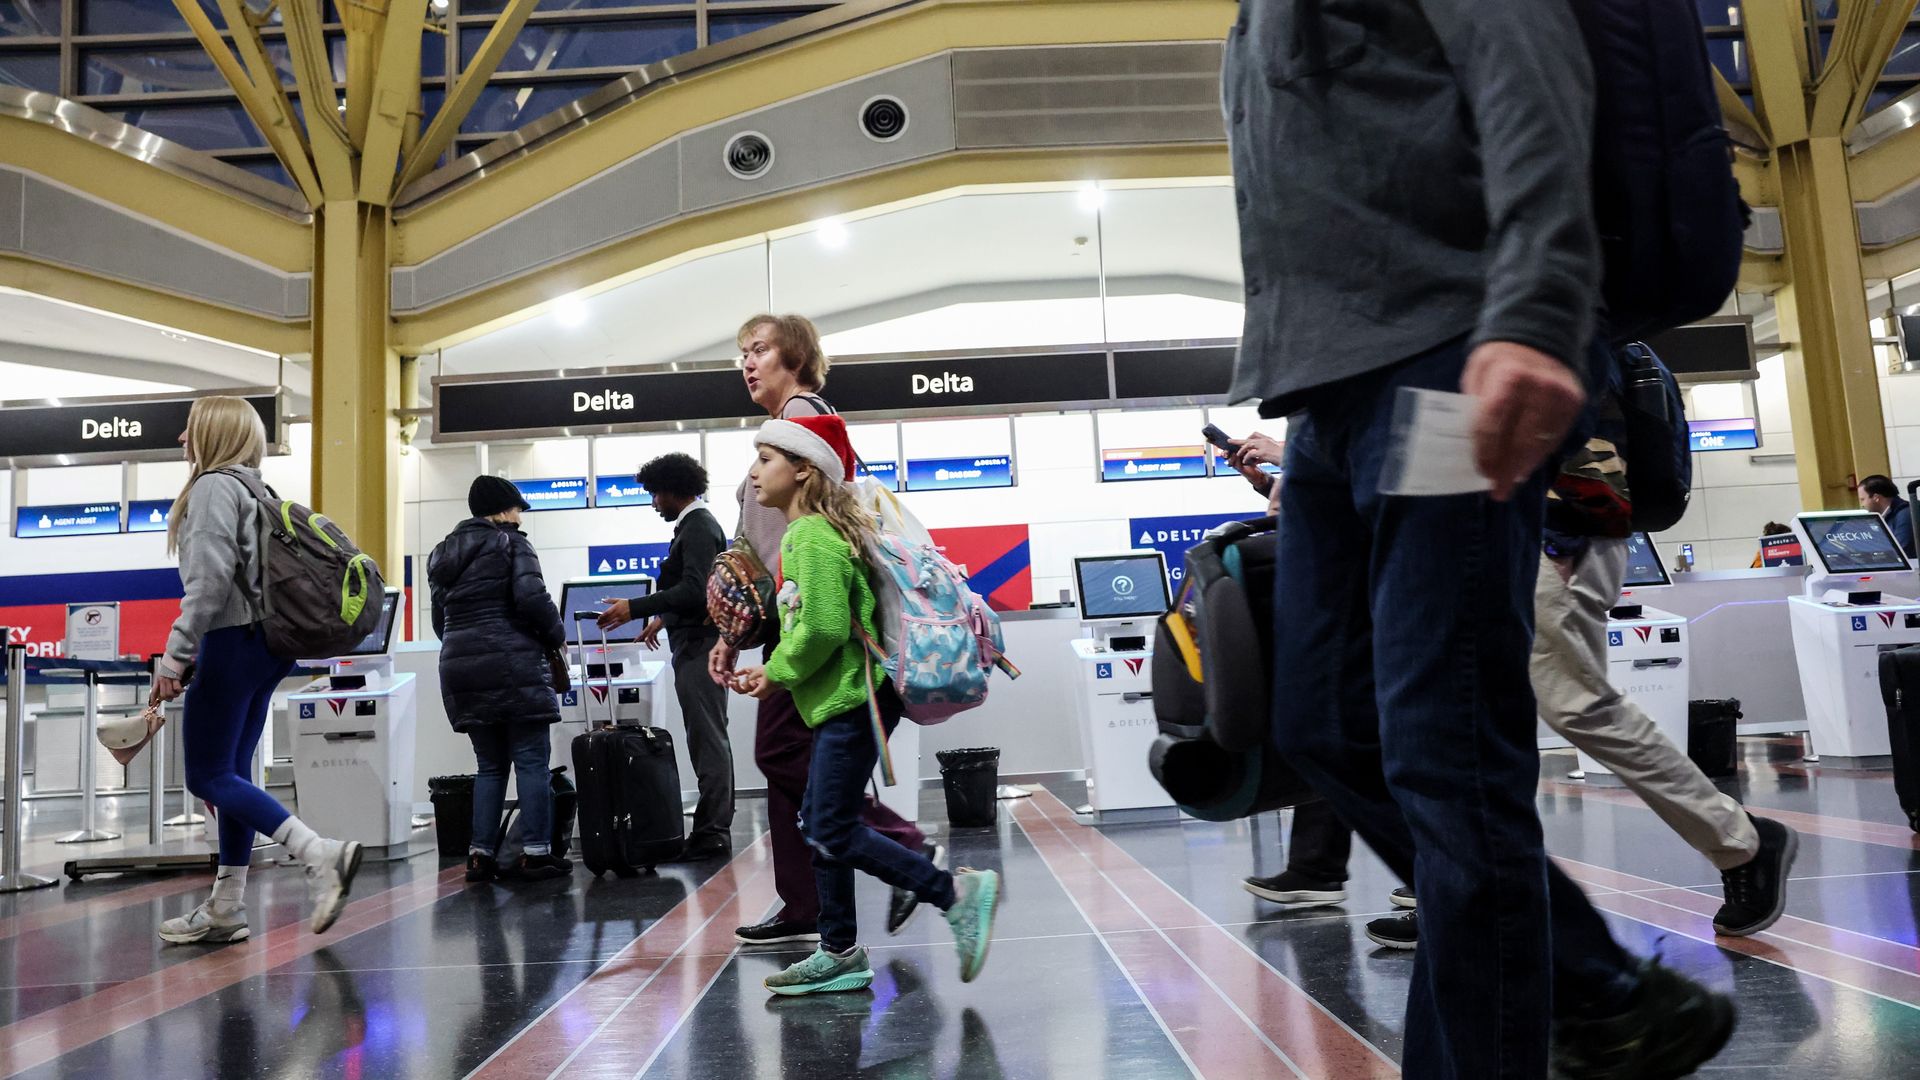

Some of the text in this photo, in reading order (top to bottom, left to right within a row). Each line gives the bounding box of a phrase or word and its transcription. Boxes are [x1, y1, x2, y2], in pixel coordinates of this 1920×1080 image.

[912, 371, 974, 394] Delta
[573, 389, 634, 412] Delta
[82, 416, 142, 440] Delta
[1700, 436, 1725, 447] ONE
[54, 517, 97, 526] AGENT ASSIST
[1826, 531, 1873, 542] CHECK IN
[616, 557, 668, 570] DELT
[1630, 684, 1664, 693] DELTA
[322, 758, 358, 767] DELTA
